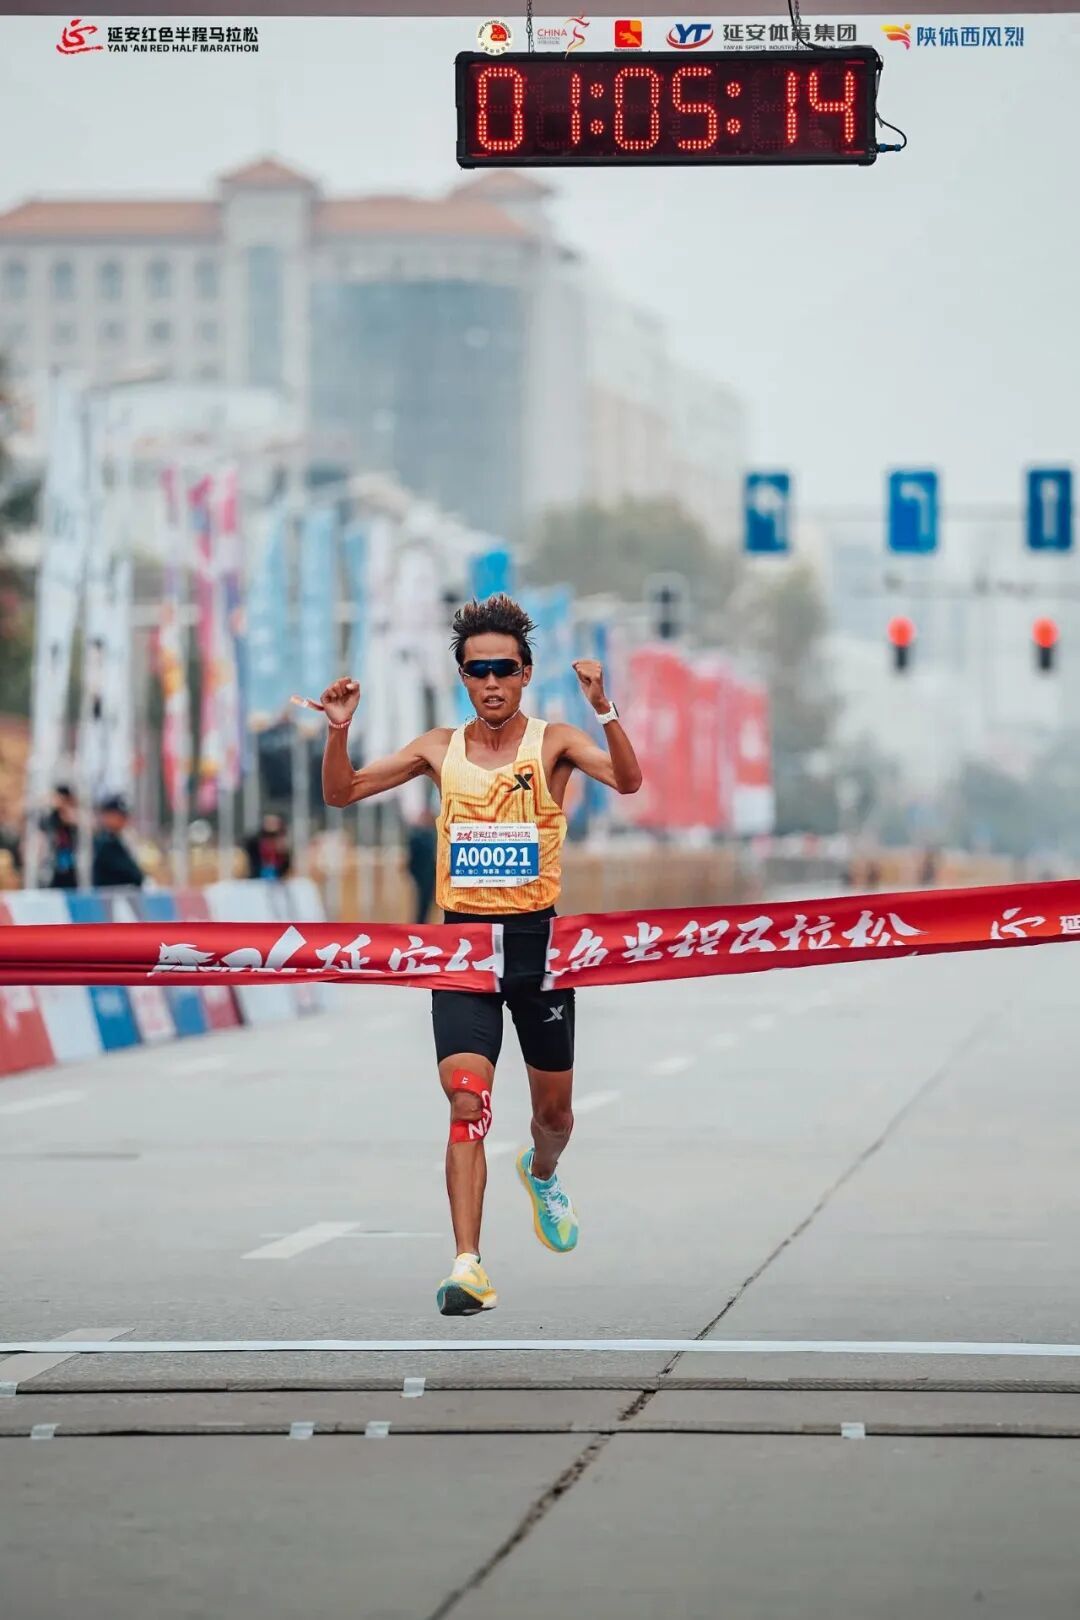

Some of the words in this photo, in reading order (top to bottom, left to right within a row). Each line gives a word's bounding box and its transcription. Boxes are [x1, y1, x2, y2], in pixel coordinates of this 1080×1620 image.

[107, 26, 259, 43] 延安红色半程马拉松
[536, 28, 568, 37] CHINA
[722, 24, 857, 42] 延安体育集团
[916, 26, 1025, 47] 陕体西风烈
[150, 44, 170, 52] RED
[172, 44, 198, 52] HALF
[200, 44, 259, 52] MARATHON
[477, 66, 854, 151] 01:05:14
[455, 846, 532, 867] A00021
